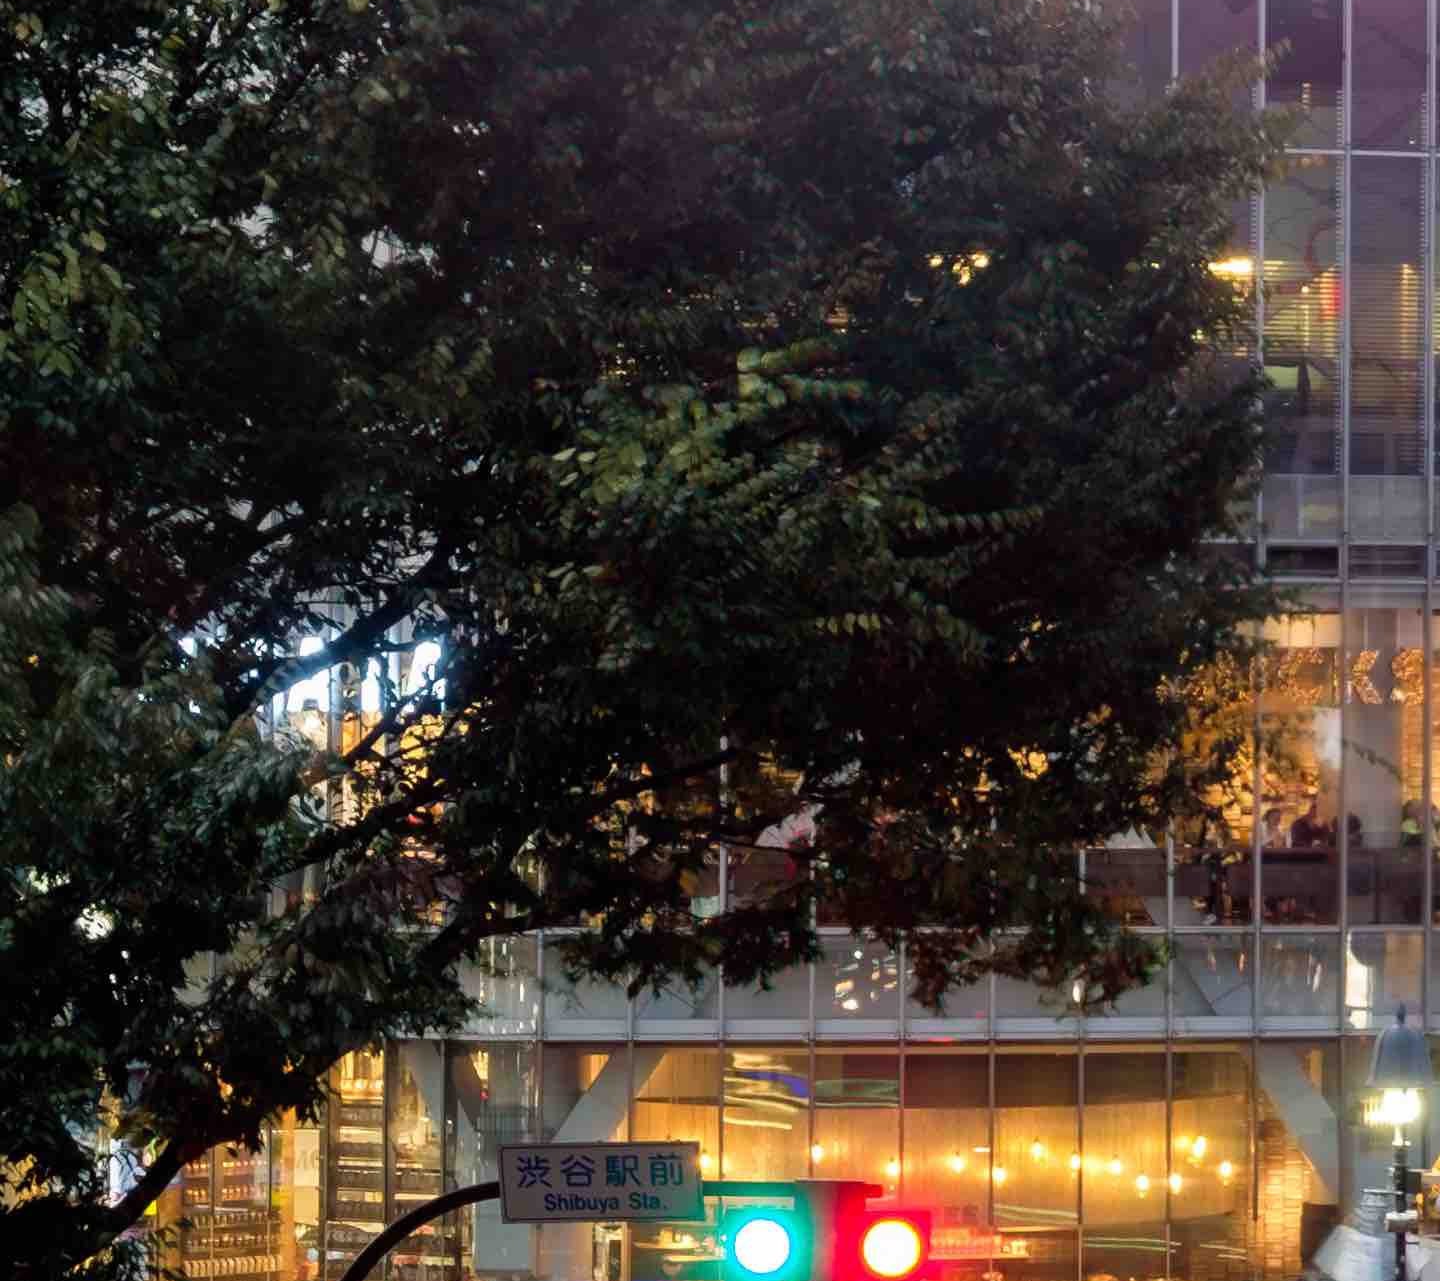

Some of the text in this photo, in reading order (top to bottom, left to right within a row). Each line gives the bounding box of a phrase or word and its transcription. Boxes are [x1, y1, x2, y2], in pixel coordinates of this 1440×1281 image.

[515, 1152, 686, 1188] 渋谷駅前
[544, 1191, 668, 1215] Shibuya Sta.
